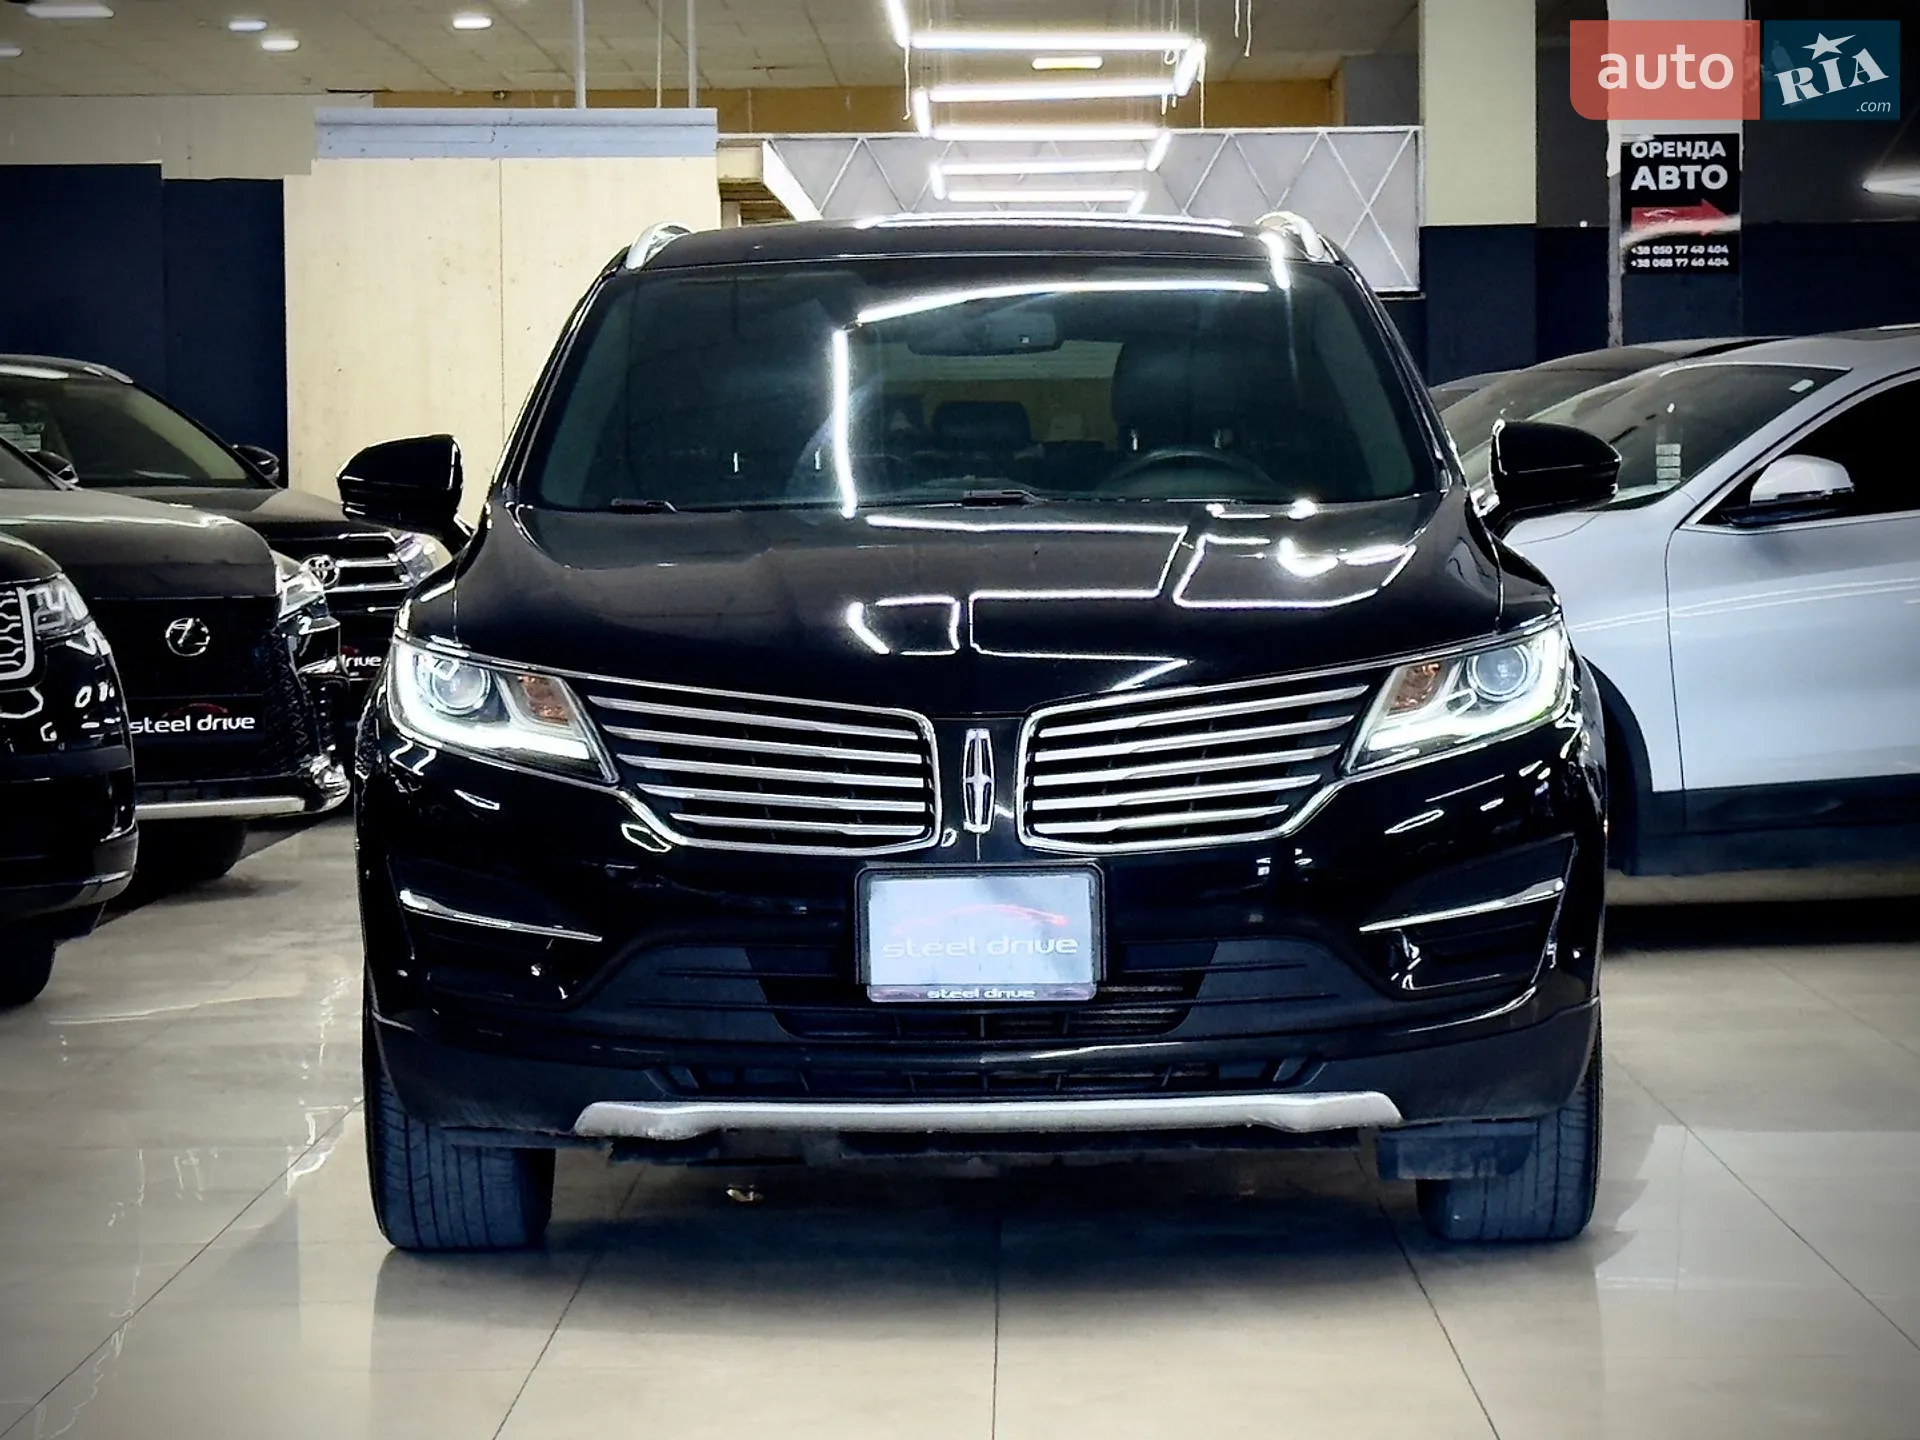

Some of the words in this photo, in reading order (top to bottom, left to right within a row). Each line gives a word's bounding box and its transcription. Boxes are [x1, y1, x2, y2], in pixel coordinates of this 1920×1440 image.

[1630, 140, 1727, 160] ОРЕНДА
[1630, 164, 1729, 191] АВТО
[129, 714, 191, 734] steel
[196, 714, 256, 731] drive
[882, 936, 976, 958] steel
[986, 935, 1078, 956] drive
[926, 988, 980, 999] steel
[983, 988, 1036, 999] drive
